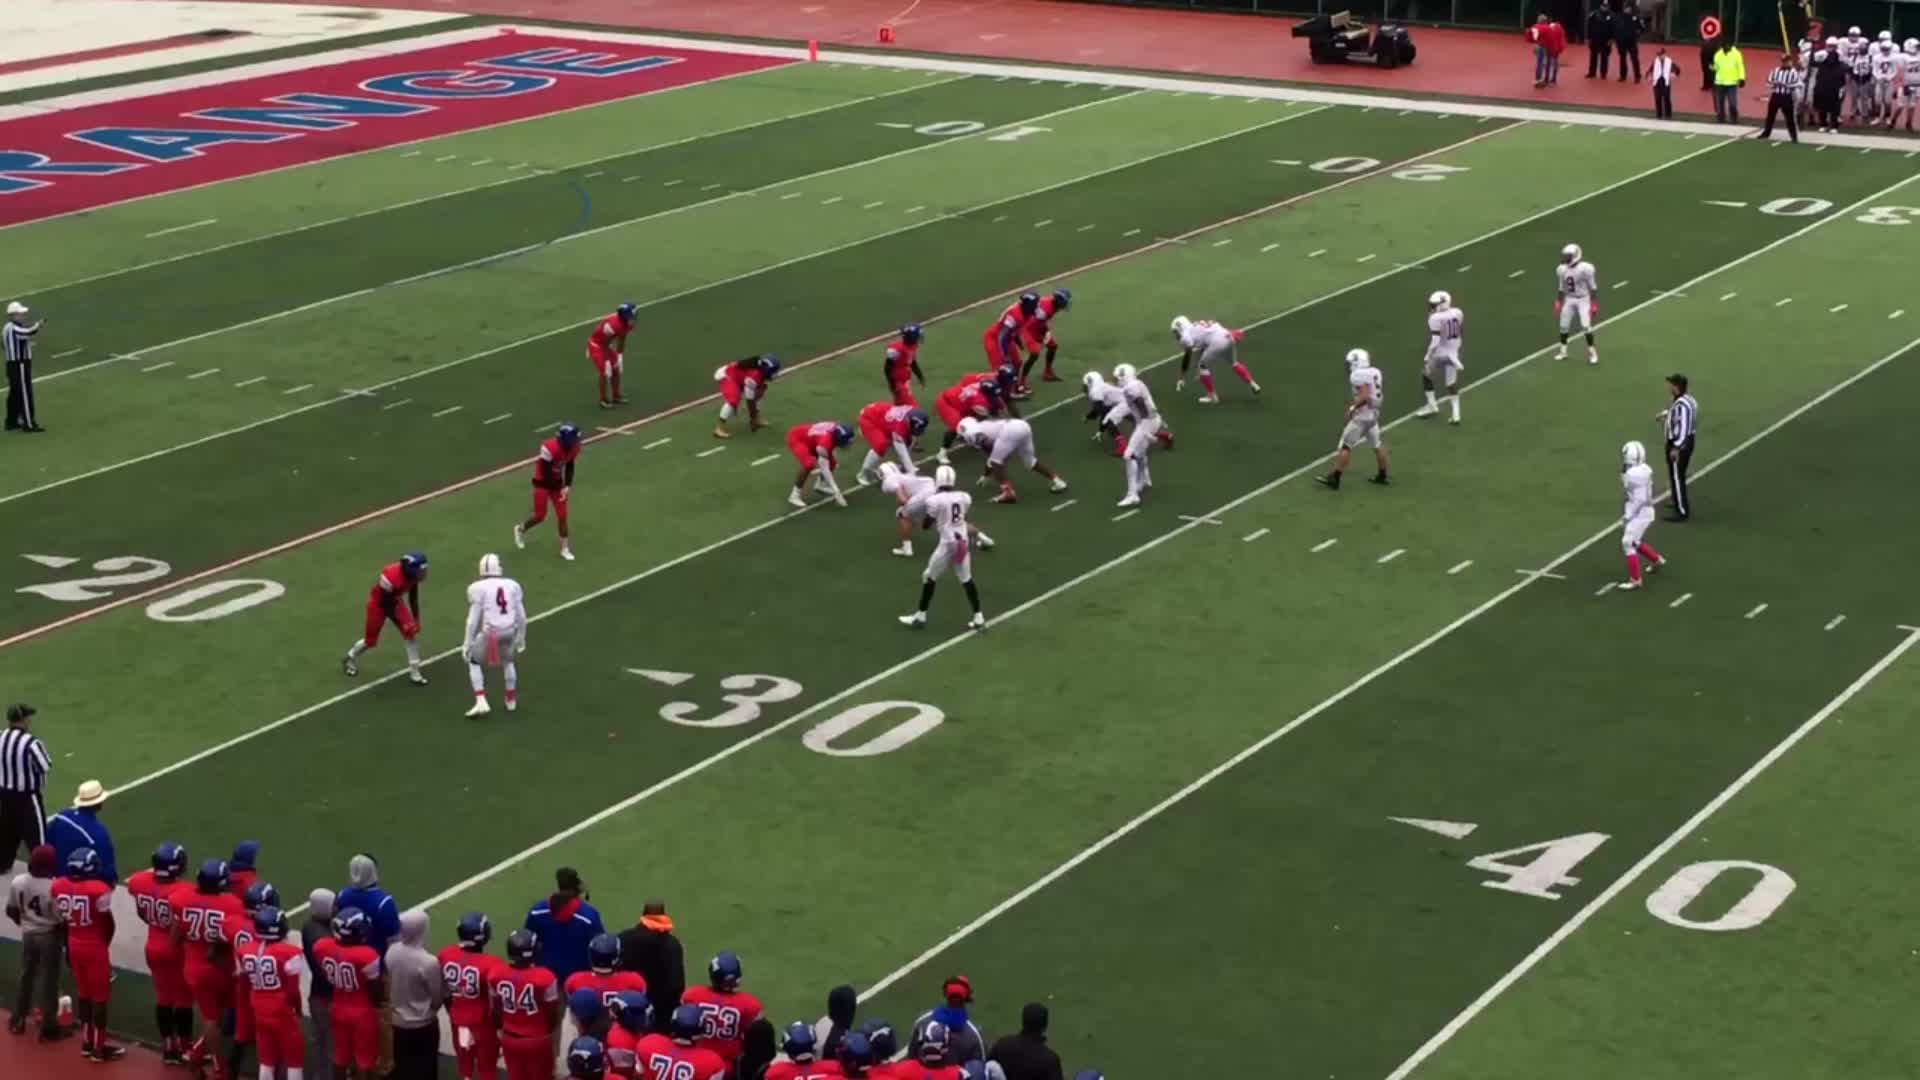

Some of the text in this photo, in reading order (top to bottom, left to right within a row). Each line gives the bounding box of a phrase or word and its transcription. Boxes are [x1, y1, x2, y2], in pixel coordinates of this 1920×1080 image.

[951, 503, 961, 523] 8
[15, 555, 286, 622] 20
[495, 587, 508, 614] 4
[658, 674, 945, 757] 30
[1465, 832, 1797, 931] 40
[183, 907, 225, 943] 75
